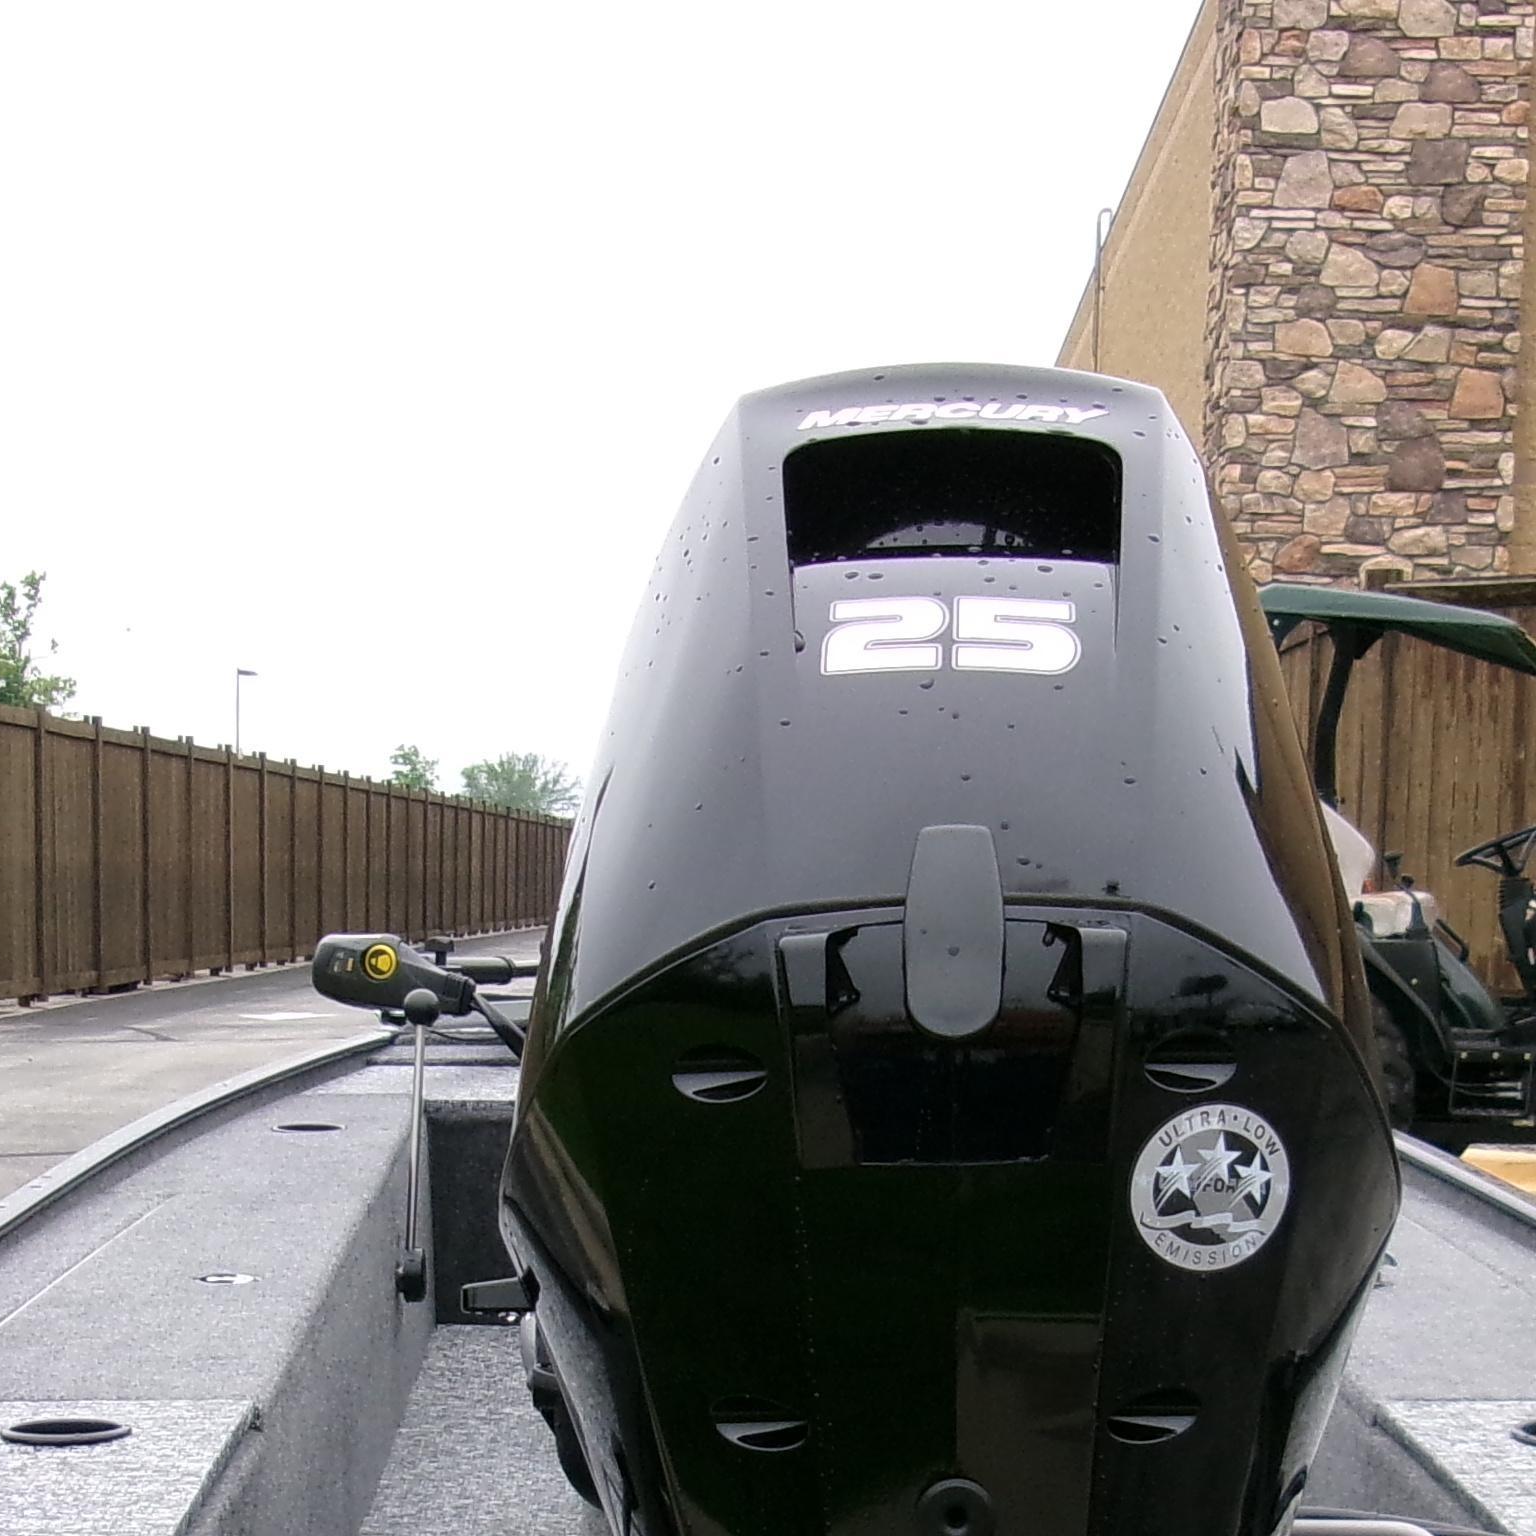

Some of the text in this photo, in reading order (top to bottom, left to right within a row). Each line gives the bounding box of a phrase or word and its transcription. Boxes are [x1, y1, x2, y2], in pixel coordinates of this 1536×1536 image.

[798, 403, 1111, 430] MERCURY
[820, 596, 1082, 675] 25
[1158, 1110, 1282, 1156] ULTRA LOW
[1154, 1232, 1259, 1265] EMISSION
